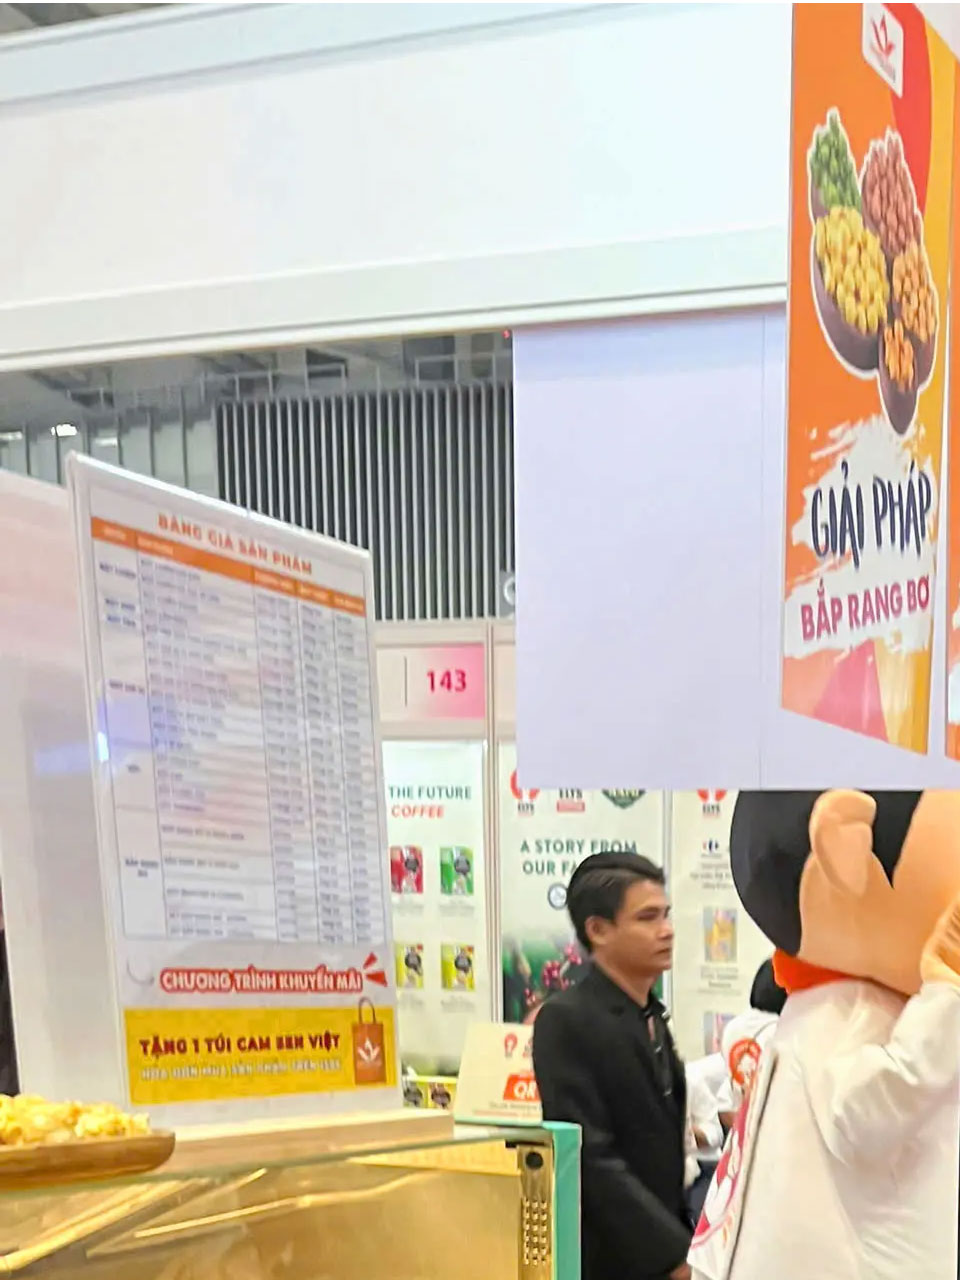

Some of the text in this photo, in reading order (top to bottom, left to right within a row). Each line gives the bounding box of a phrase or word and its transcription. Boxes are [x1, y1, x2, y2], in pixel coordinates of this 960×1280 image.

[811, 459, 932, 570] GIẢI PHÁP
[800, 575, 930, 642] BẮP RANG BƠ
[426, 669, 467, 693] 143
[389, 785, 472, 800] THE FUTURE
[391, 805, 445, 819] COFFEE
[520, 839, 637, 853] A STORY FROM
[522, 861, 557, 875] OUR
[162, 967, 232, 990] CHƯƠNG
[234, 964, 276, 990] TRÌNH
[139, 1033, 187, 1059] TẶNG
[193, 1039, 200, 1054] 1
[204, 1032, 231, 1054] TÚI
